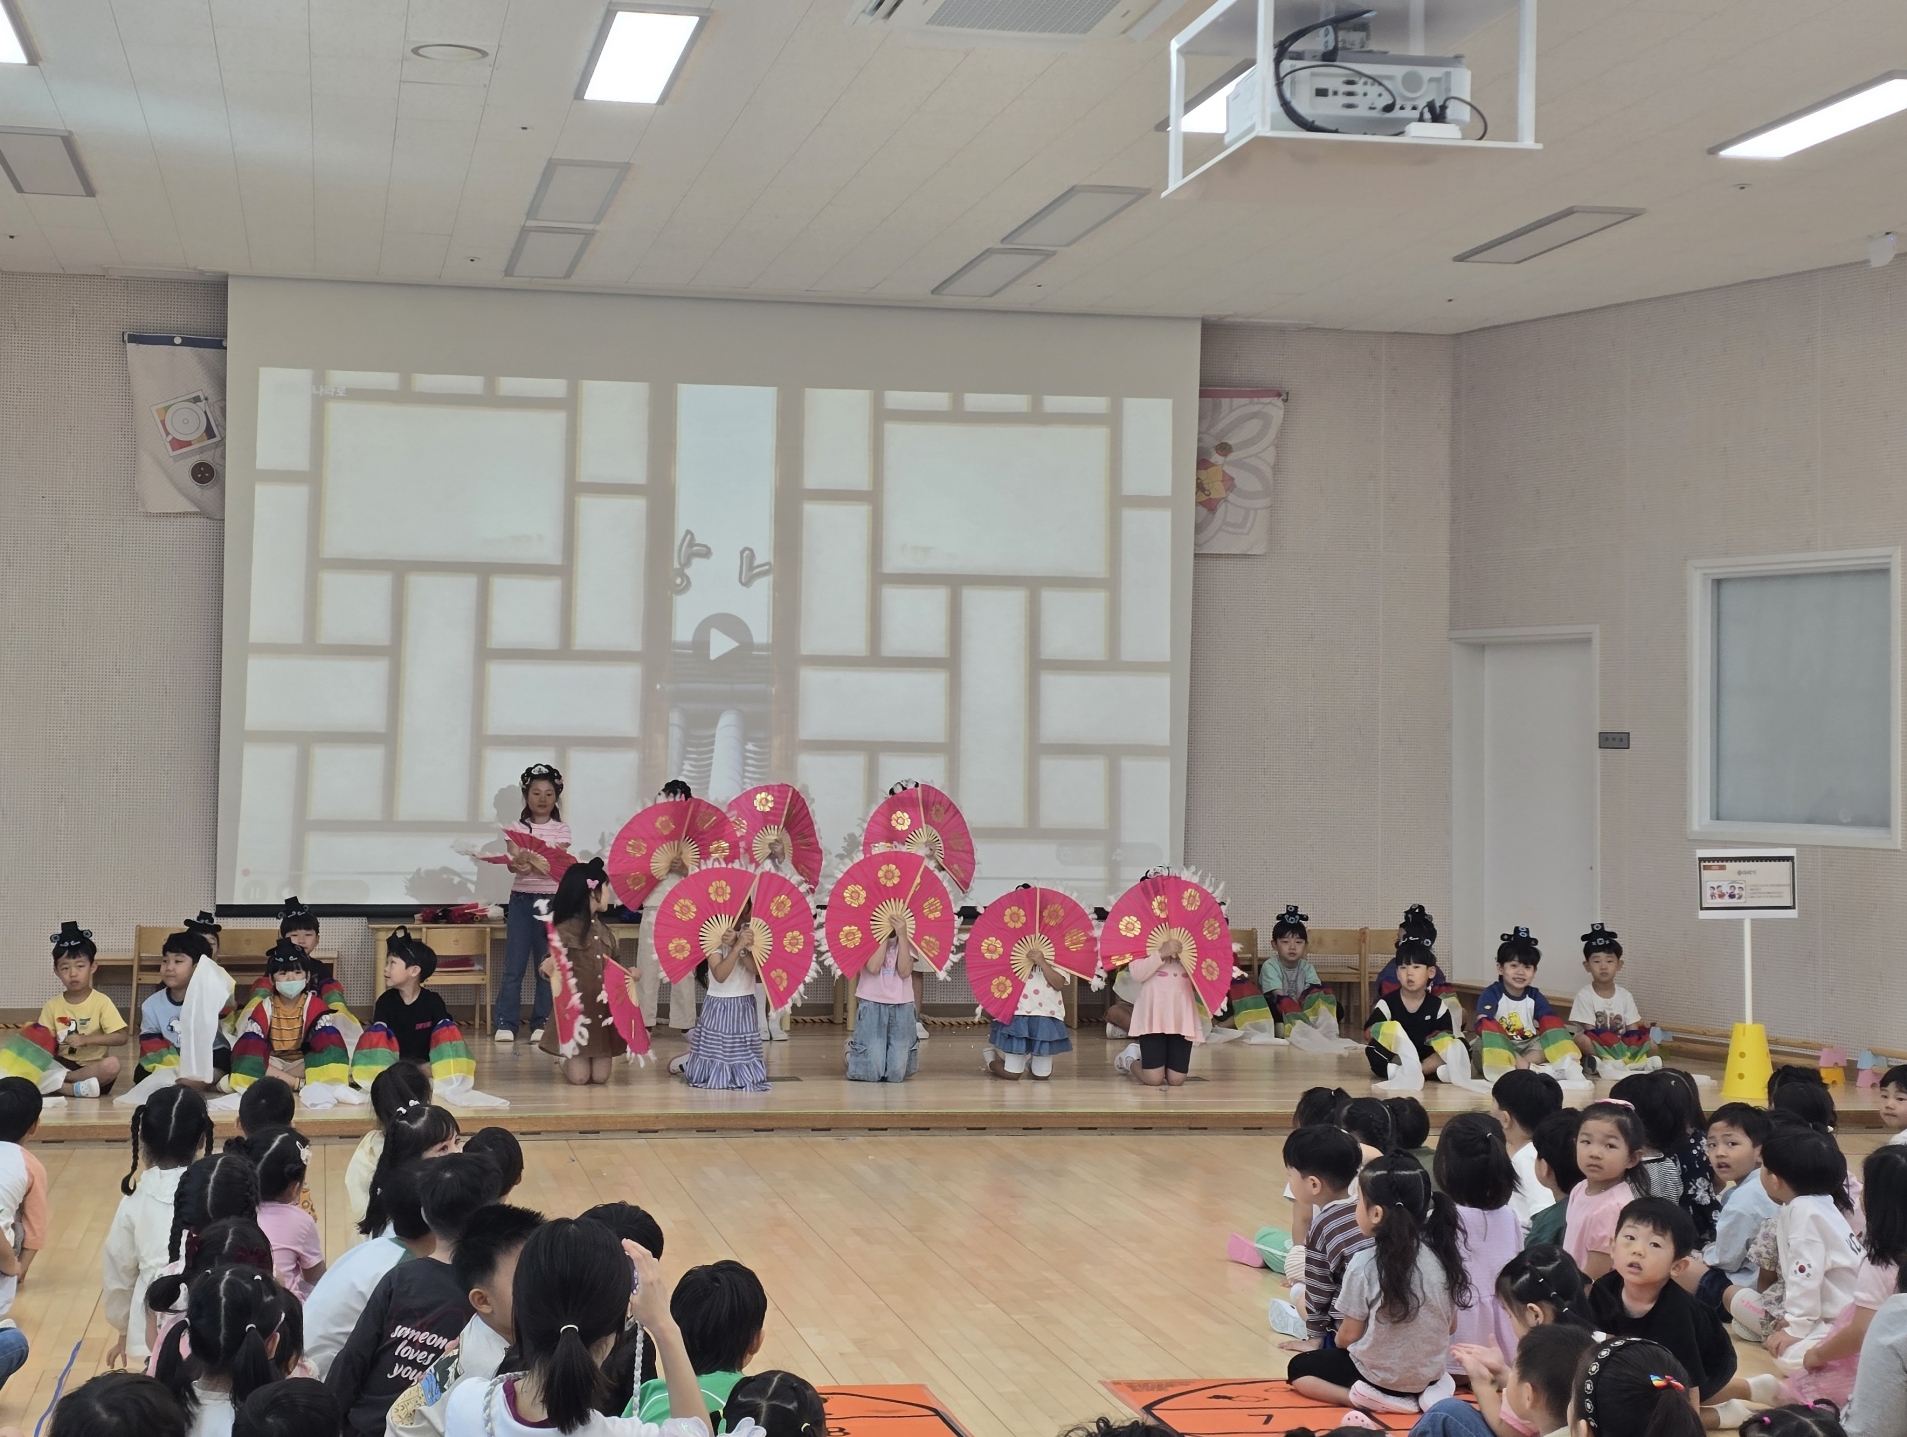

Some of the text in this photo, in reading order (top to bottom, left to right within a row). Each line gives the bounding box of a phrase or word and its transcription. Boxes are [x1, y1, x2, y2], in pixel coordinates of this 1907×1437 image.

[390, 1324, 449, 1350] someon
[394, 1339, 436, 1366] loves
[386, 1362, 423, 1383] you
